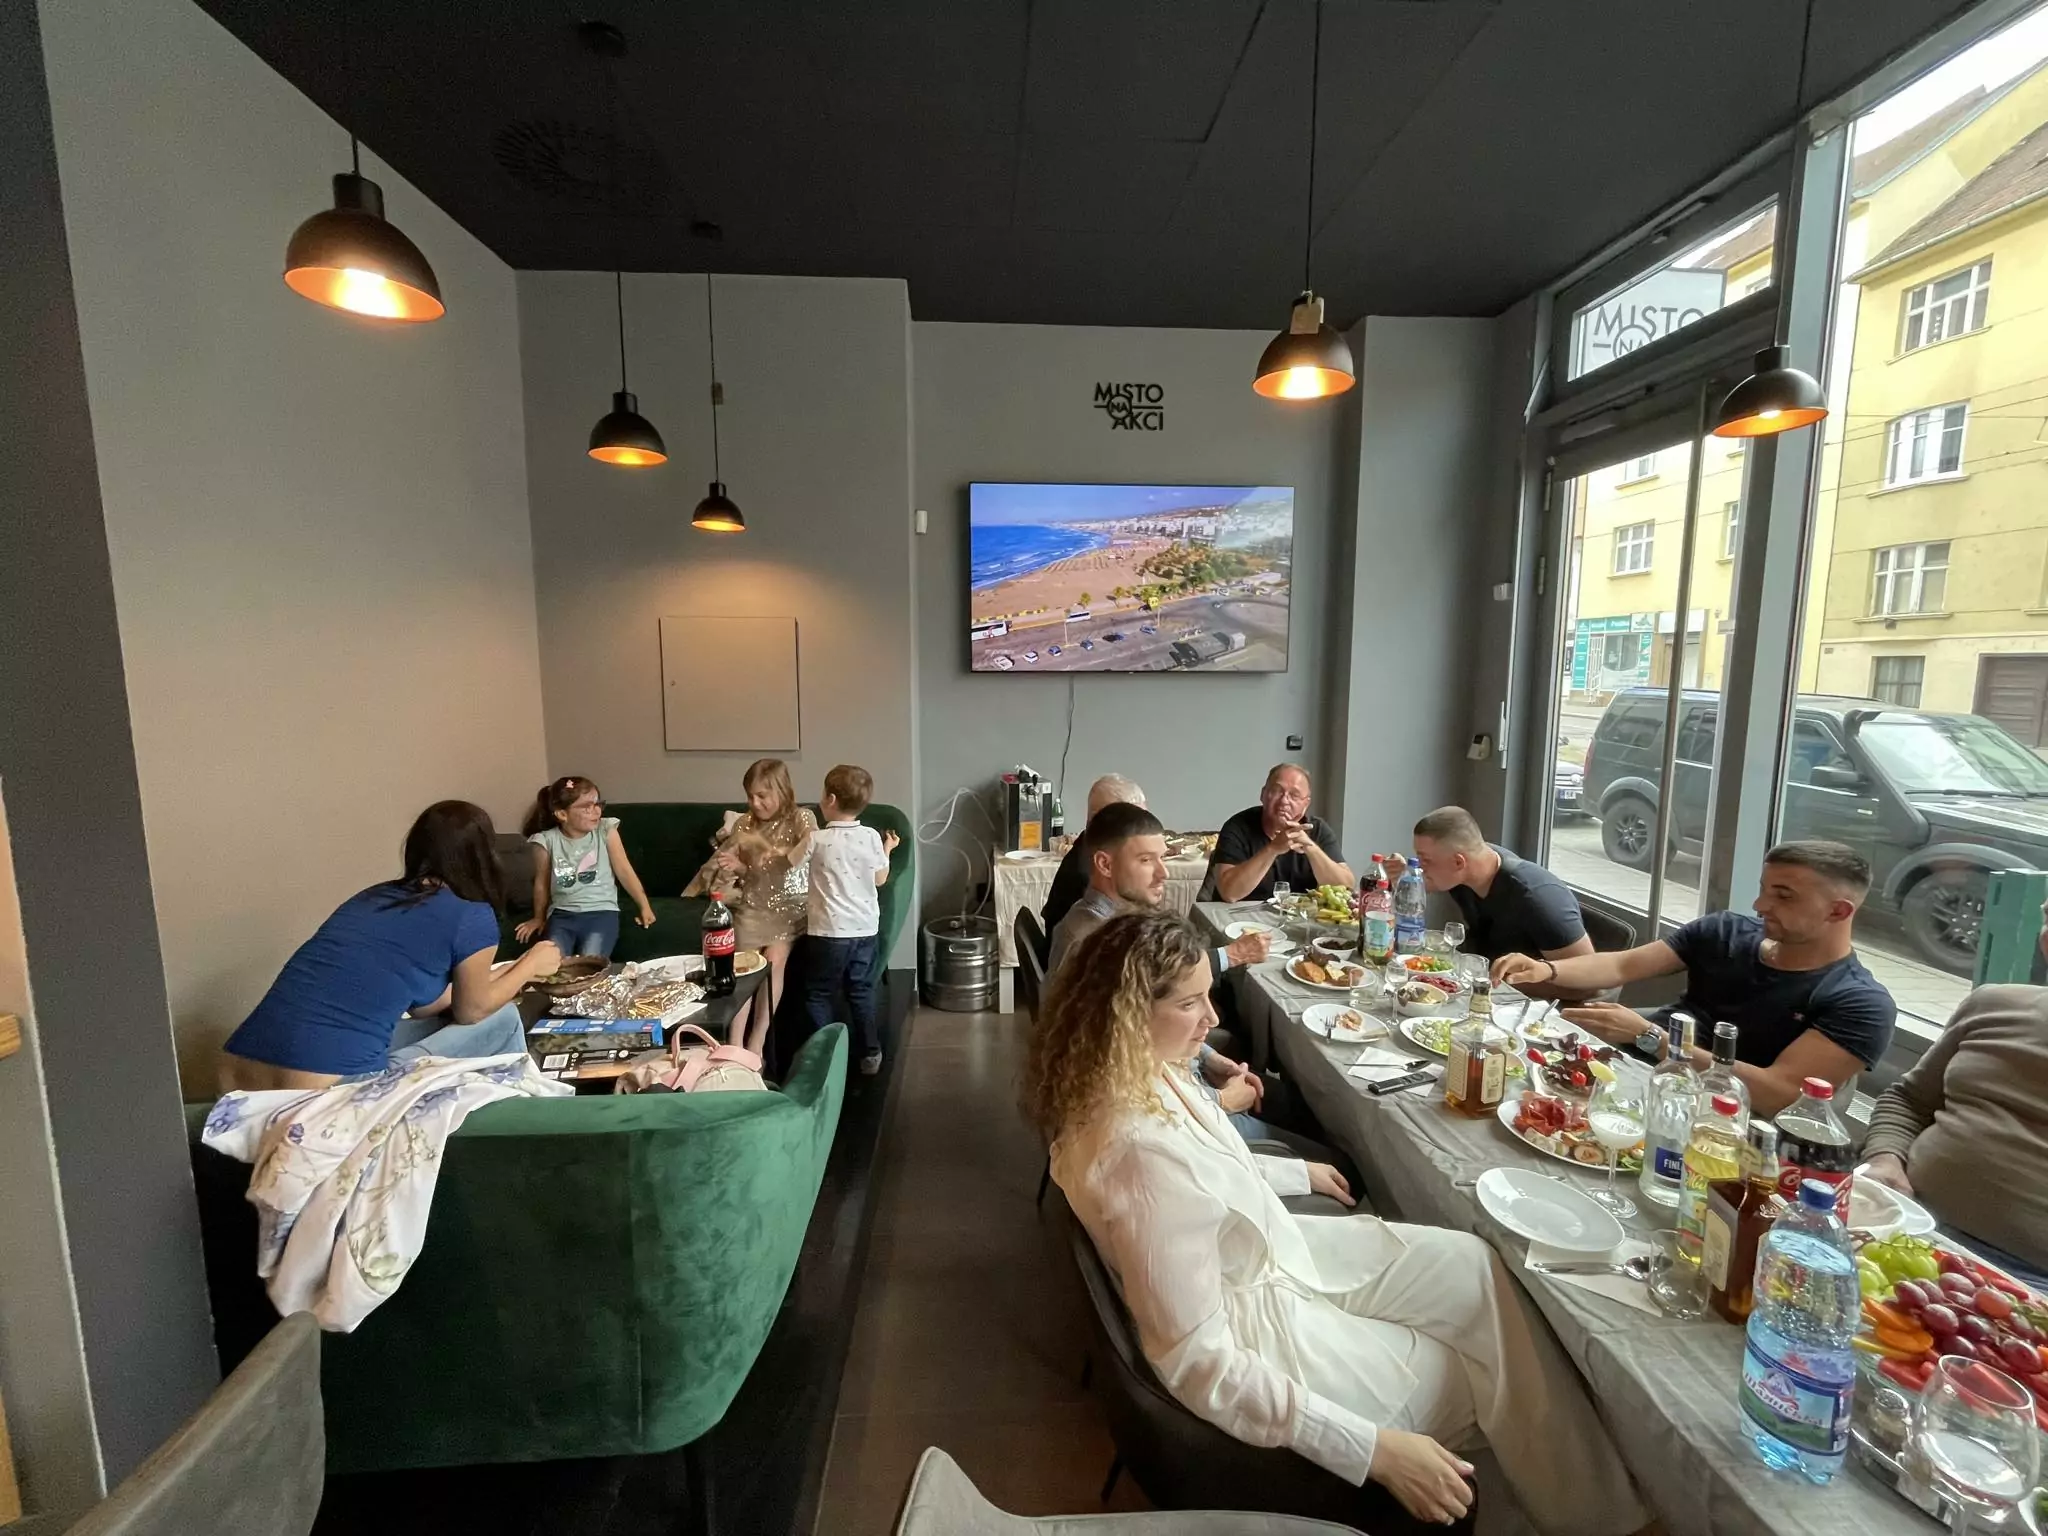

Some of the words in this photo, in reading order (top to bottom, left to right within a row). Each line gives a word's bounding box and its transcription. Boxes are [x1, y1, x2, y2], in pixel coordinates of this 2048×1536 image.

[1094, 382, 1164, 403] MISTO
[1110, 401, 1129, 413] NA
[1111, 411, 1164, 431] AKCI
[1663, 1158, 1681, 1170] FINL
